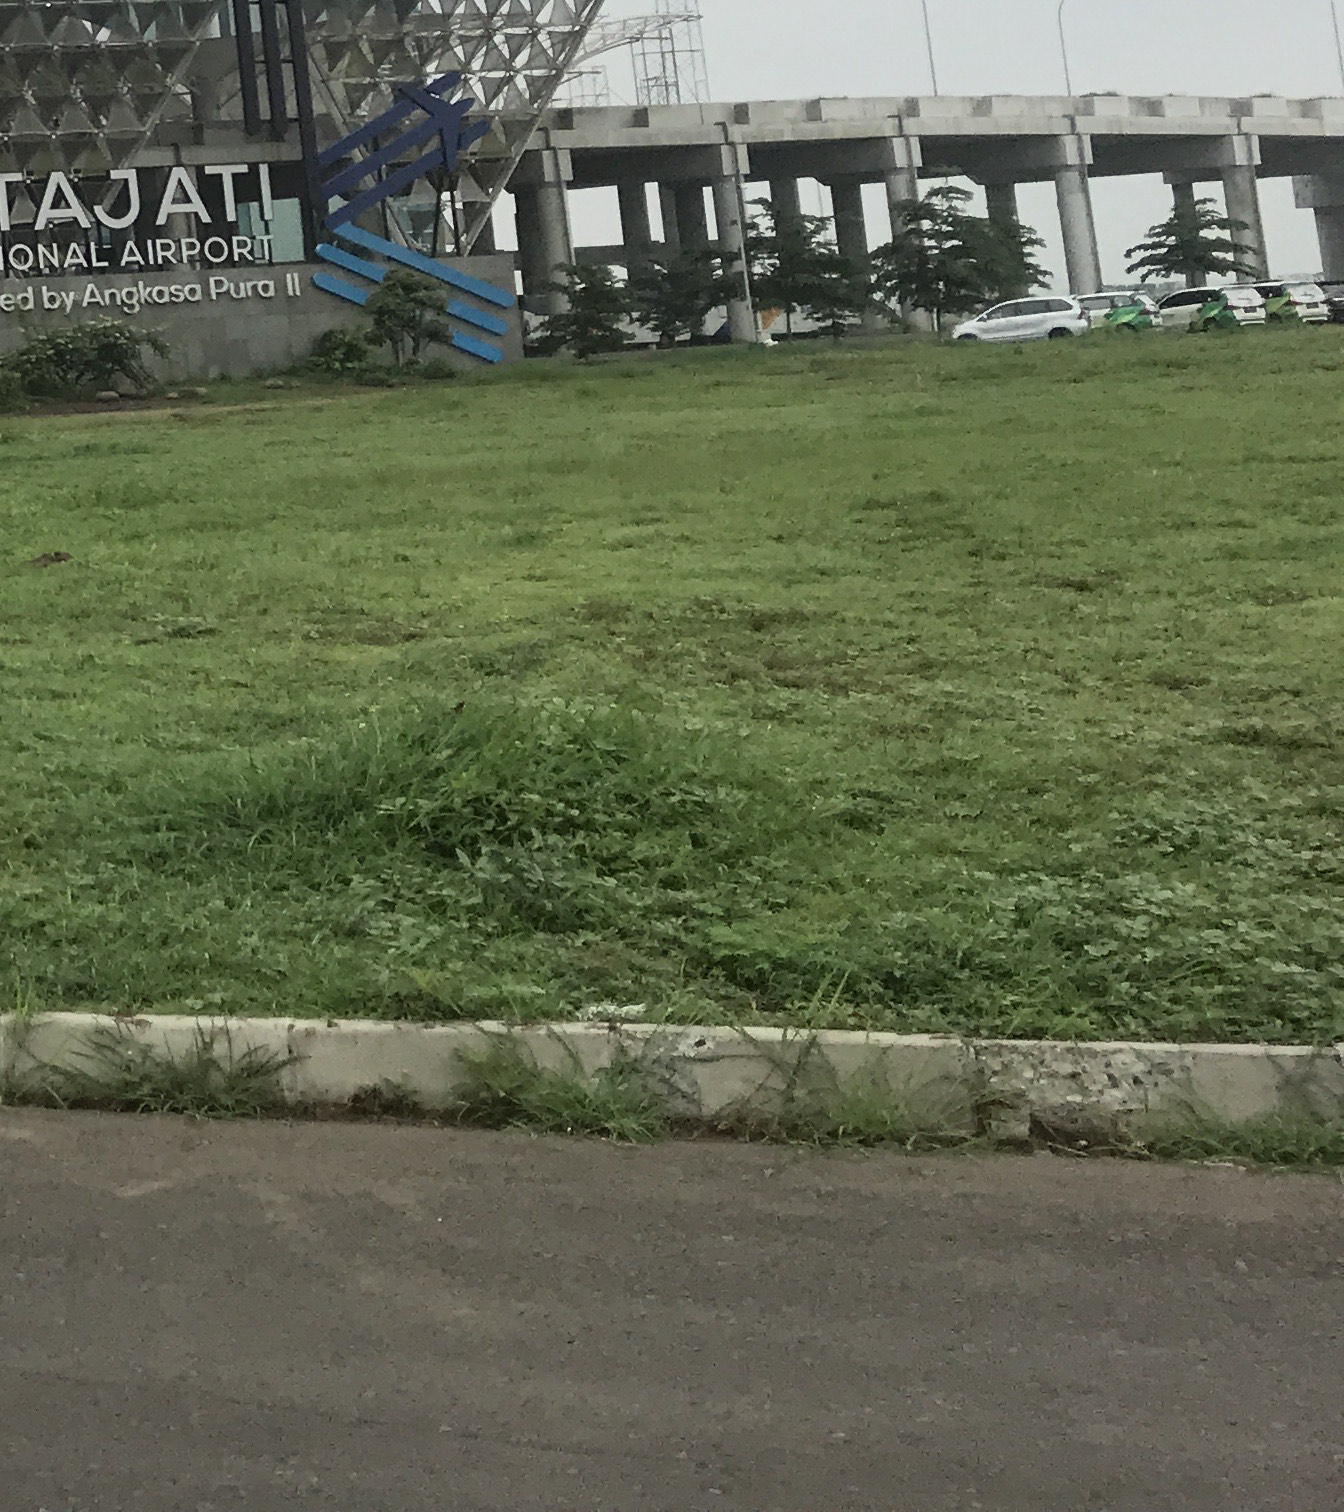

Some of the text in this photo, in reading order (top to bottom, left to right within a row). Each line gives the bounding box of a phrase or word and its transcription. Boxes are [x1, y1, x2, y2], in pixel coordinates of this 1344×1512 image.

[120, 234, 274, 266] AIRPORT
[41, 284, 75, 313] by
[82, 282, 202, 315] Angkasa
[210, 276, 274, 301] Pura
[285, 273, 301, 298] II
